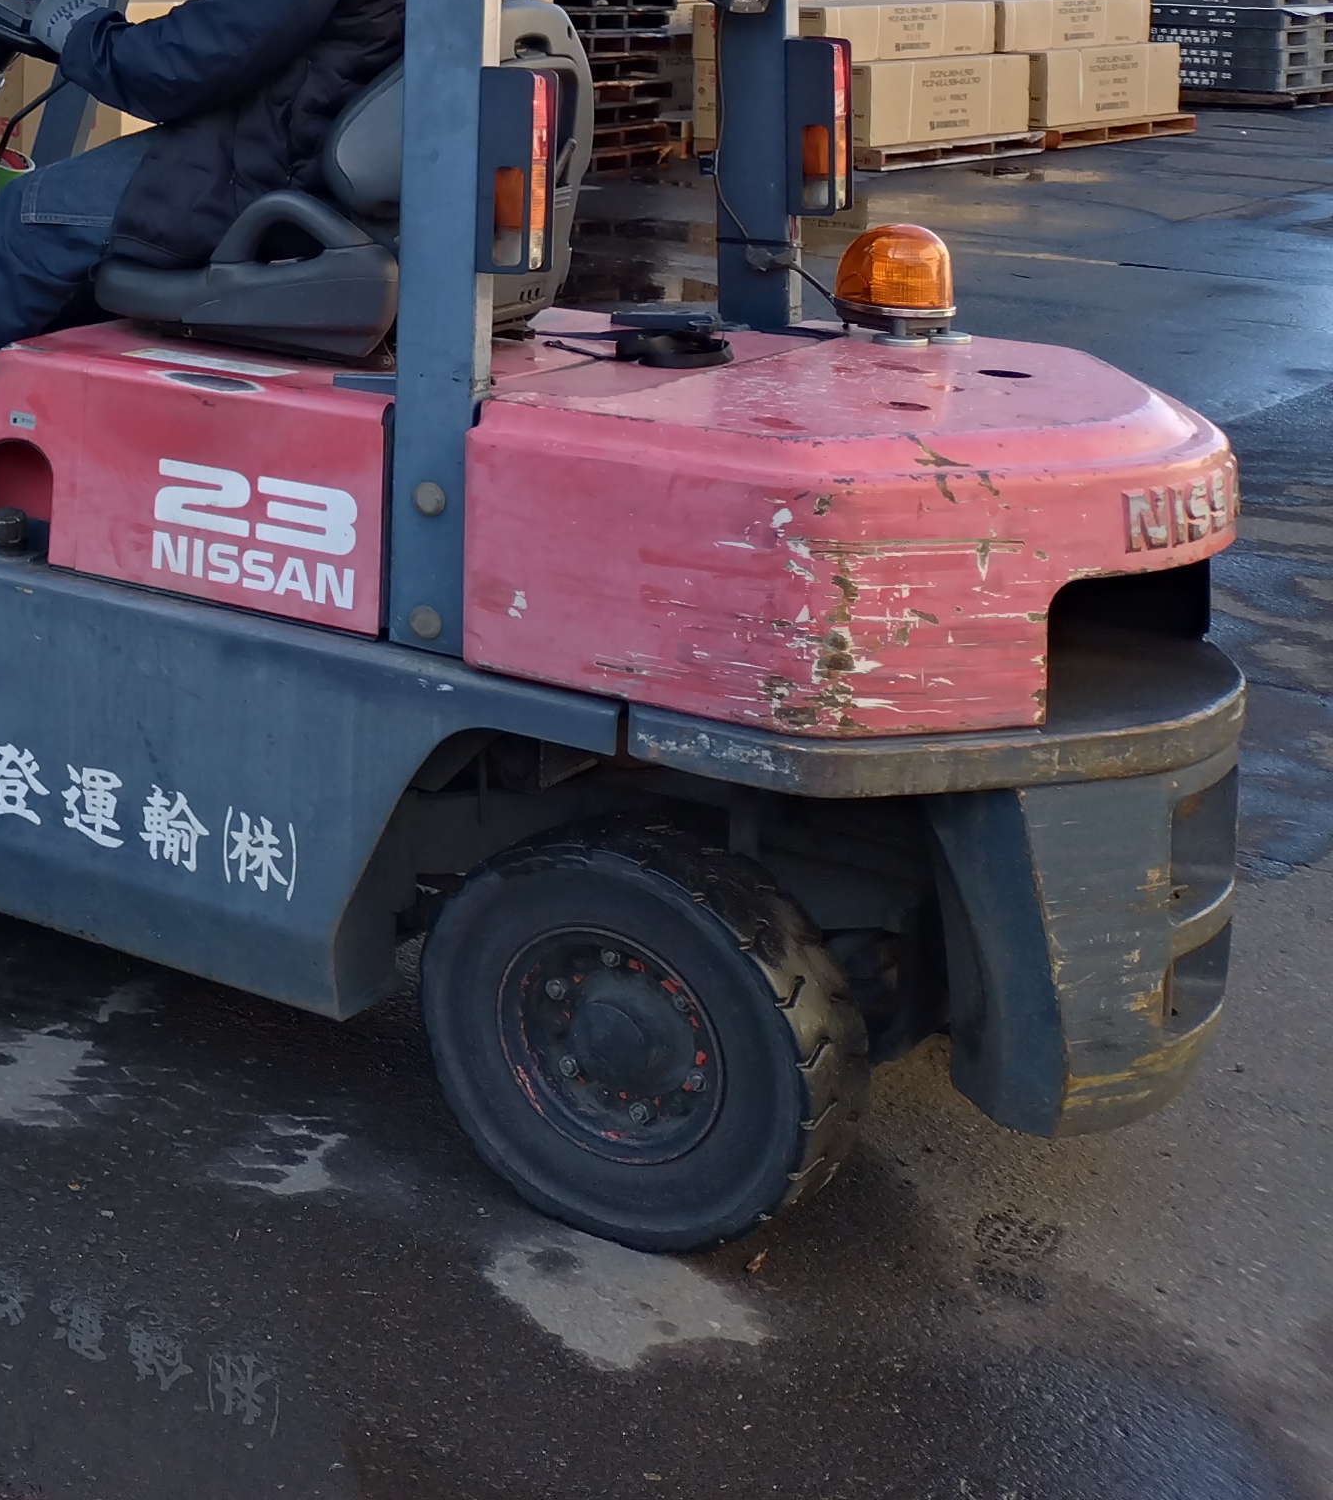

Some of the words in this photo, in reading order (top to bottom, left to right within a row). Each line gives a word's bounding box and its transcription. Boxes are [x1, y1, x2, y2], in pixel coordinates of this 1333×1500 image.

[154, 457, 358, 557] 23
[1121, 460, 1241, 554] NISS
[151, 529, 355, 610] NISSAN
